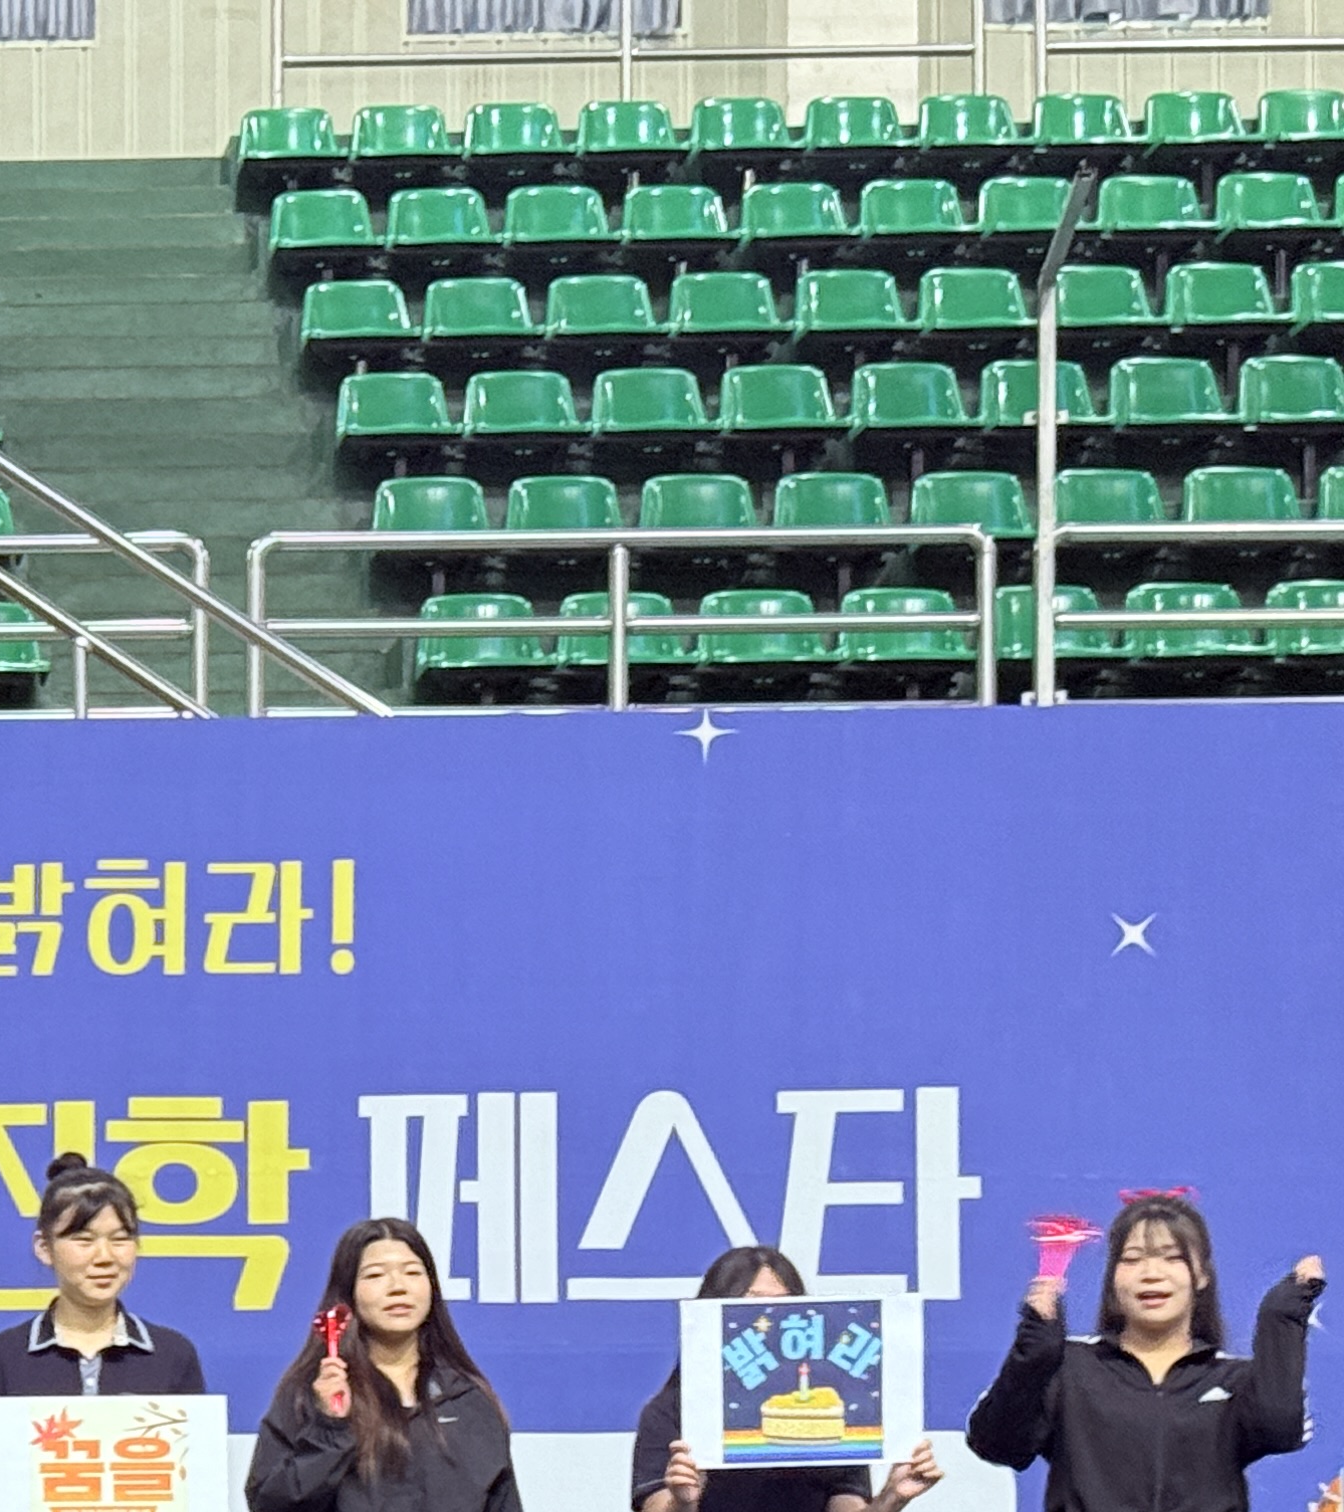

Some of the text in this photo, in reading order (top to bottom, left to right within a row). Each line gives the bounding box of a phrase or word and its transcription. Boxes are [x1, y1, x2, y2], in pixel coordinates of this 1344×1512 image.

[358, 1085, 982, 1305] 페스타
[722, 1313, 883, 1391] 밝혀라
[39, 1437, 175, 1502] 꿈을
